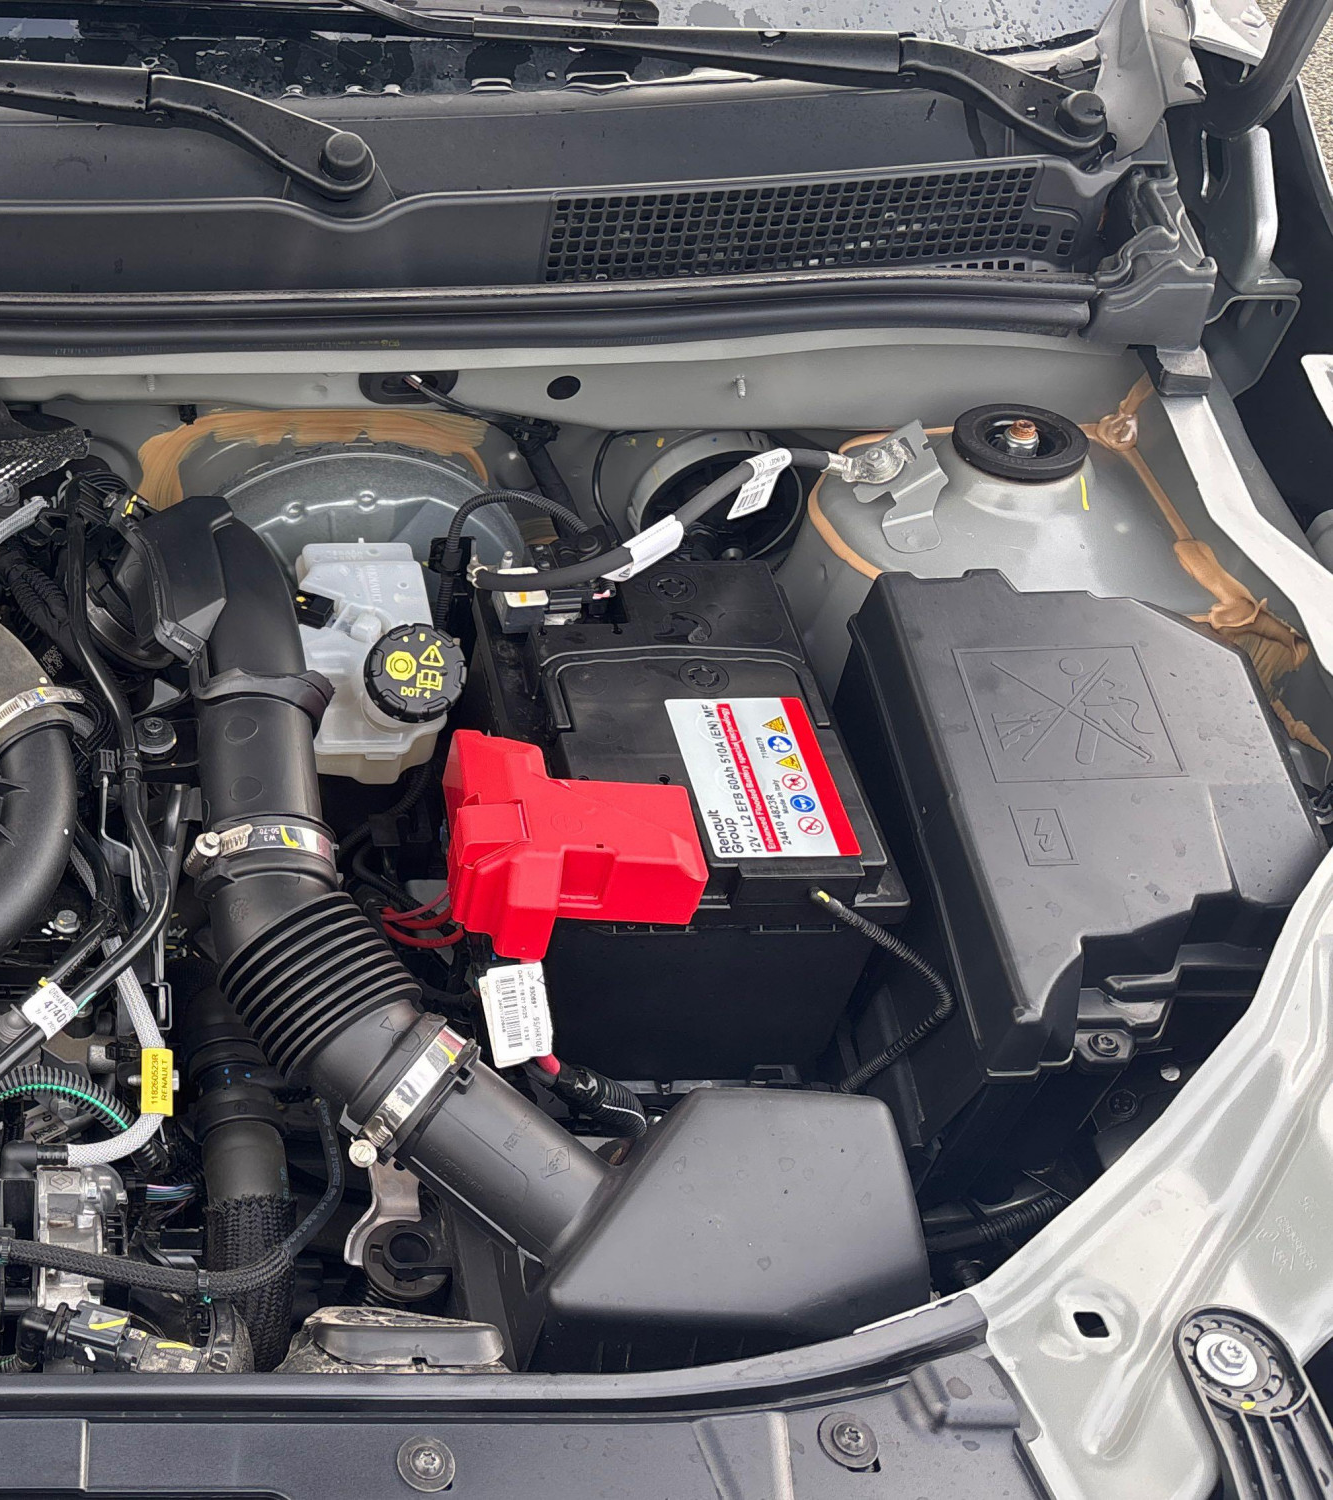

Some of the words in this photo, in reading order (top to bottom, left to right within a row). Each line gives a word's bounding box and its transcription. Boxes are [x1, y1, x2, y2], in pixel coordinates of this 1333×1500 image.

[399, 685, 422, 698] DOT
[423, 689, 431, 699] 4
[706, 719, 725, 739] (EN)
[719, 706, 737, 741] technology
[714, 740, 731, 763] 510A
[731, 741, 746, 764] special
[722, 765, 740, 790] 60Ah
[739, 764, 754, 788] Battery
[771, 778, 781, 790] Italy
[732, 792, 748, 811] EFB
[747, 788, 764, 815] Flooded
[765, 793, 781, 819] 4823R
[777, 798, 789, 813] Made
[706, 808, 732, 853] Renault
[740, 815, 753, 826] L2
[722, 817, 744, 853] Group
[747, 835, 762, 852] 12V
[756, 816, 776, 849] Enhanced
[774, 820, 792, 845] 24410
[516, 969, 524, 986] DATE
[150, 1053, 158, 1104] 118260523R
